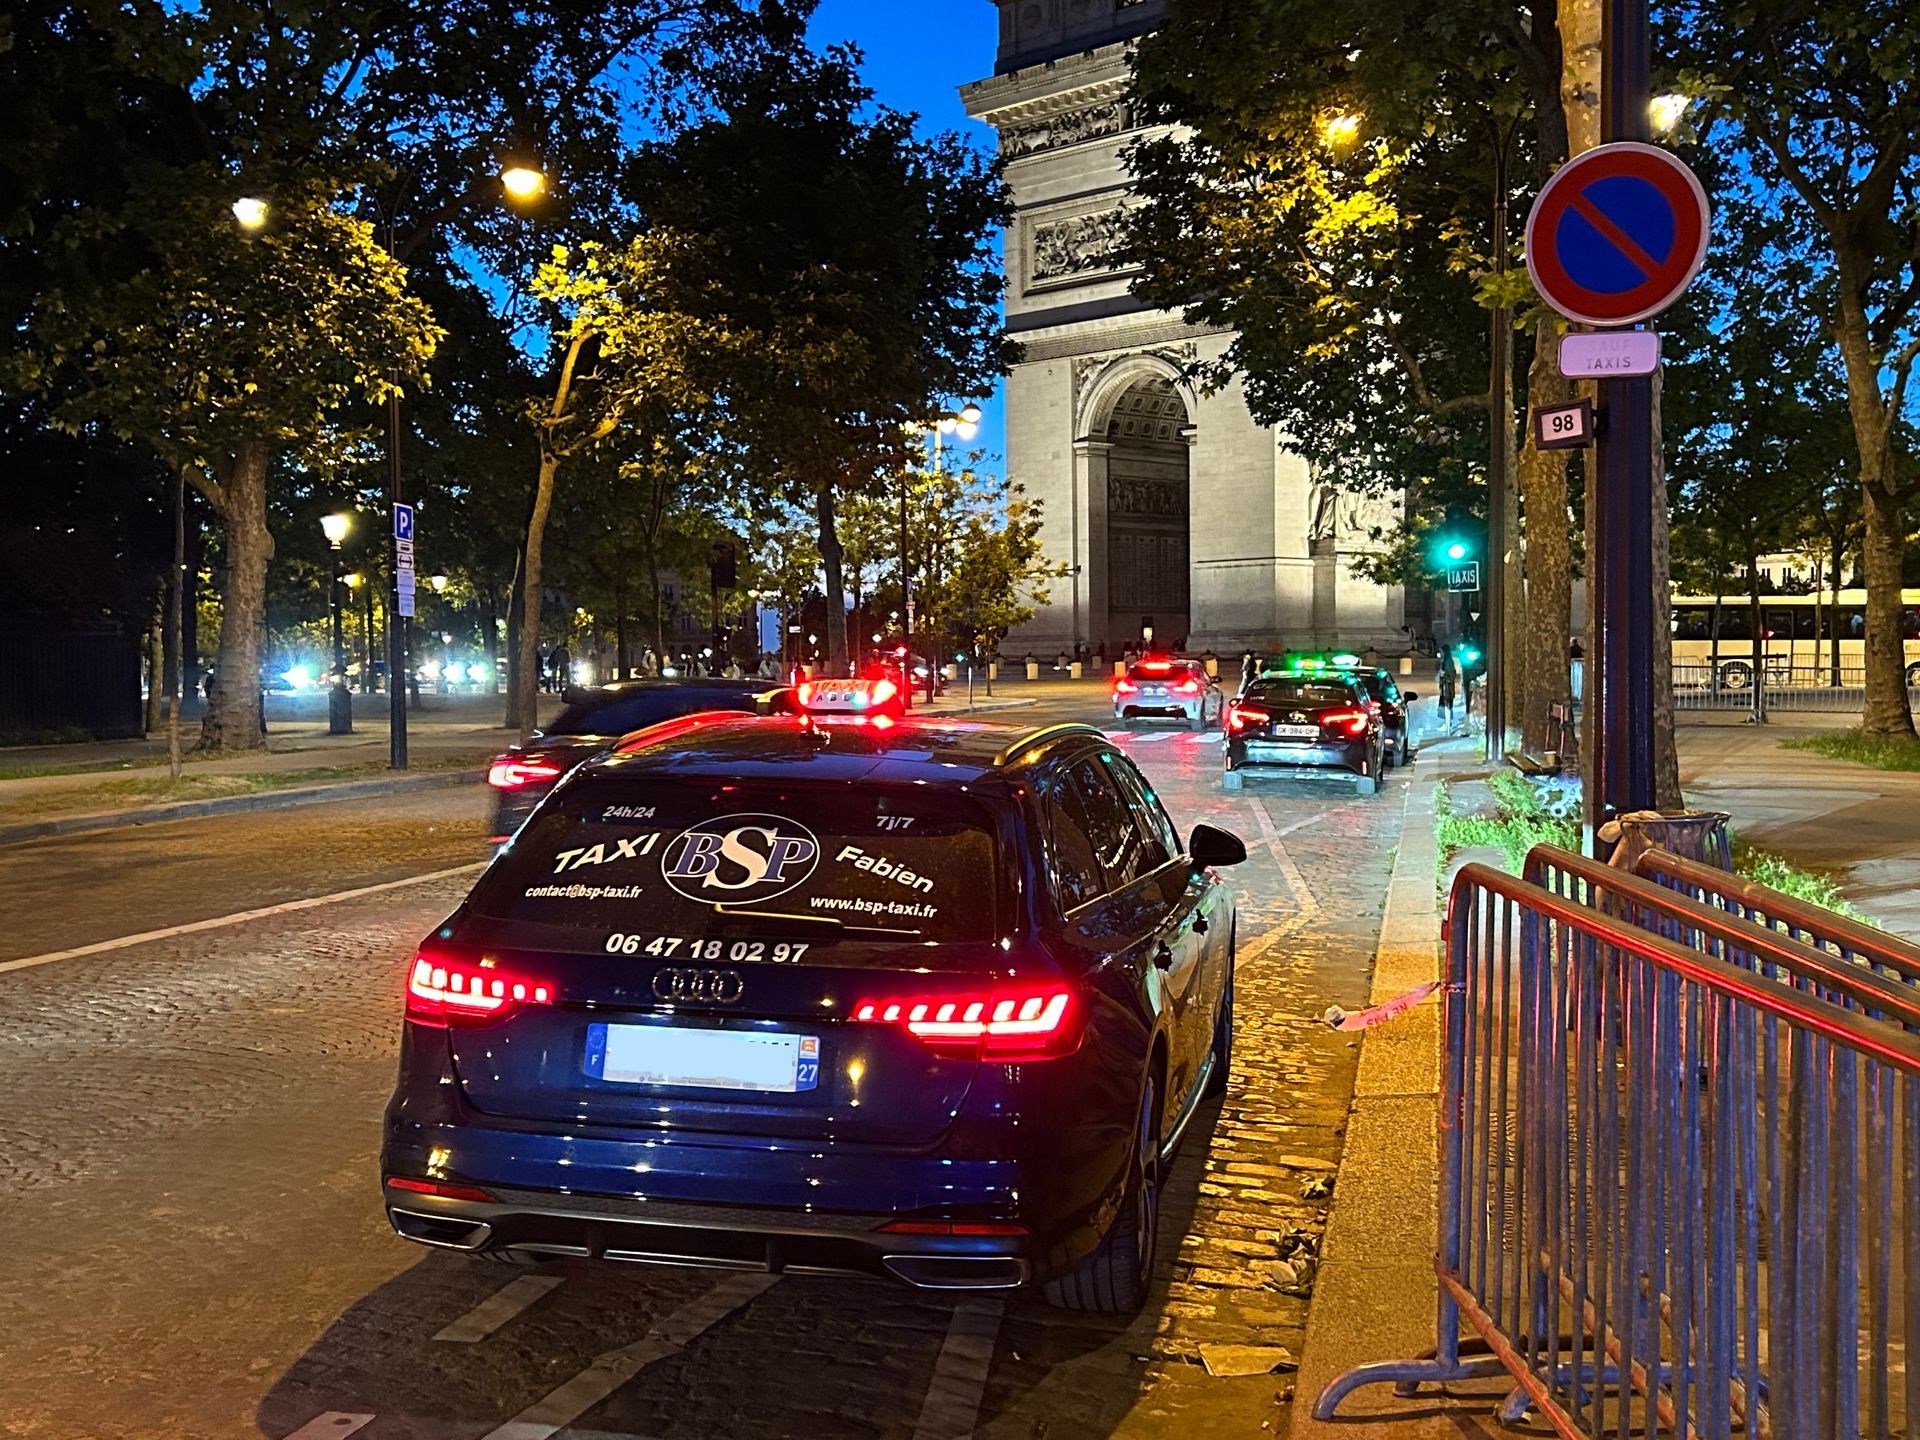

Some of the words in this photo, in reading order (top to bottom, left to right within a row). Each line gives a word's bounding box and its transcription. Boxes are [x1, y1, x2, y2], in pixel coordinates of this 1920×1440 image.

[1585, 356, 1632, 370] TAXIS
[1552, 414, 1574, 433] 98
[400, 511, 409, 533] P
[1451, 570, 1475, 584] TAXIS
[602, 805, 656, 819] 24h/24
[876, 815, 915, 831] 7j/7
[553, 832, 661, 874] TAXI
[666, 826, 815, 889] BSP
[835, 845, 934, 893] Fabien
[525, 884, 643, 900] contact@bsp-taxi.fr
[810, 897, 938, 918] www.bsp-taxi.fr
[605, 933, 641, 955] 06
[645, 937, 683, 957] 47
[689, 939, 723, 960] 18
[729, 942, 765, 962] 02
[772, 943, 809, 963] 97
[591, 1054, 599, 1066] F
[798, 1063, 818, 1082] 27
